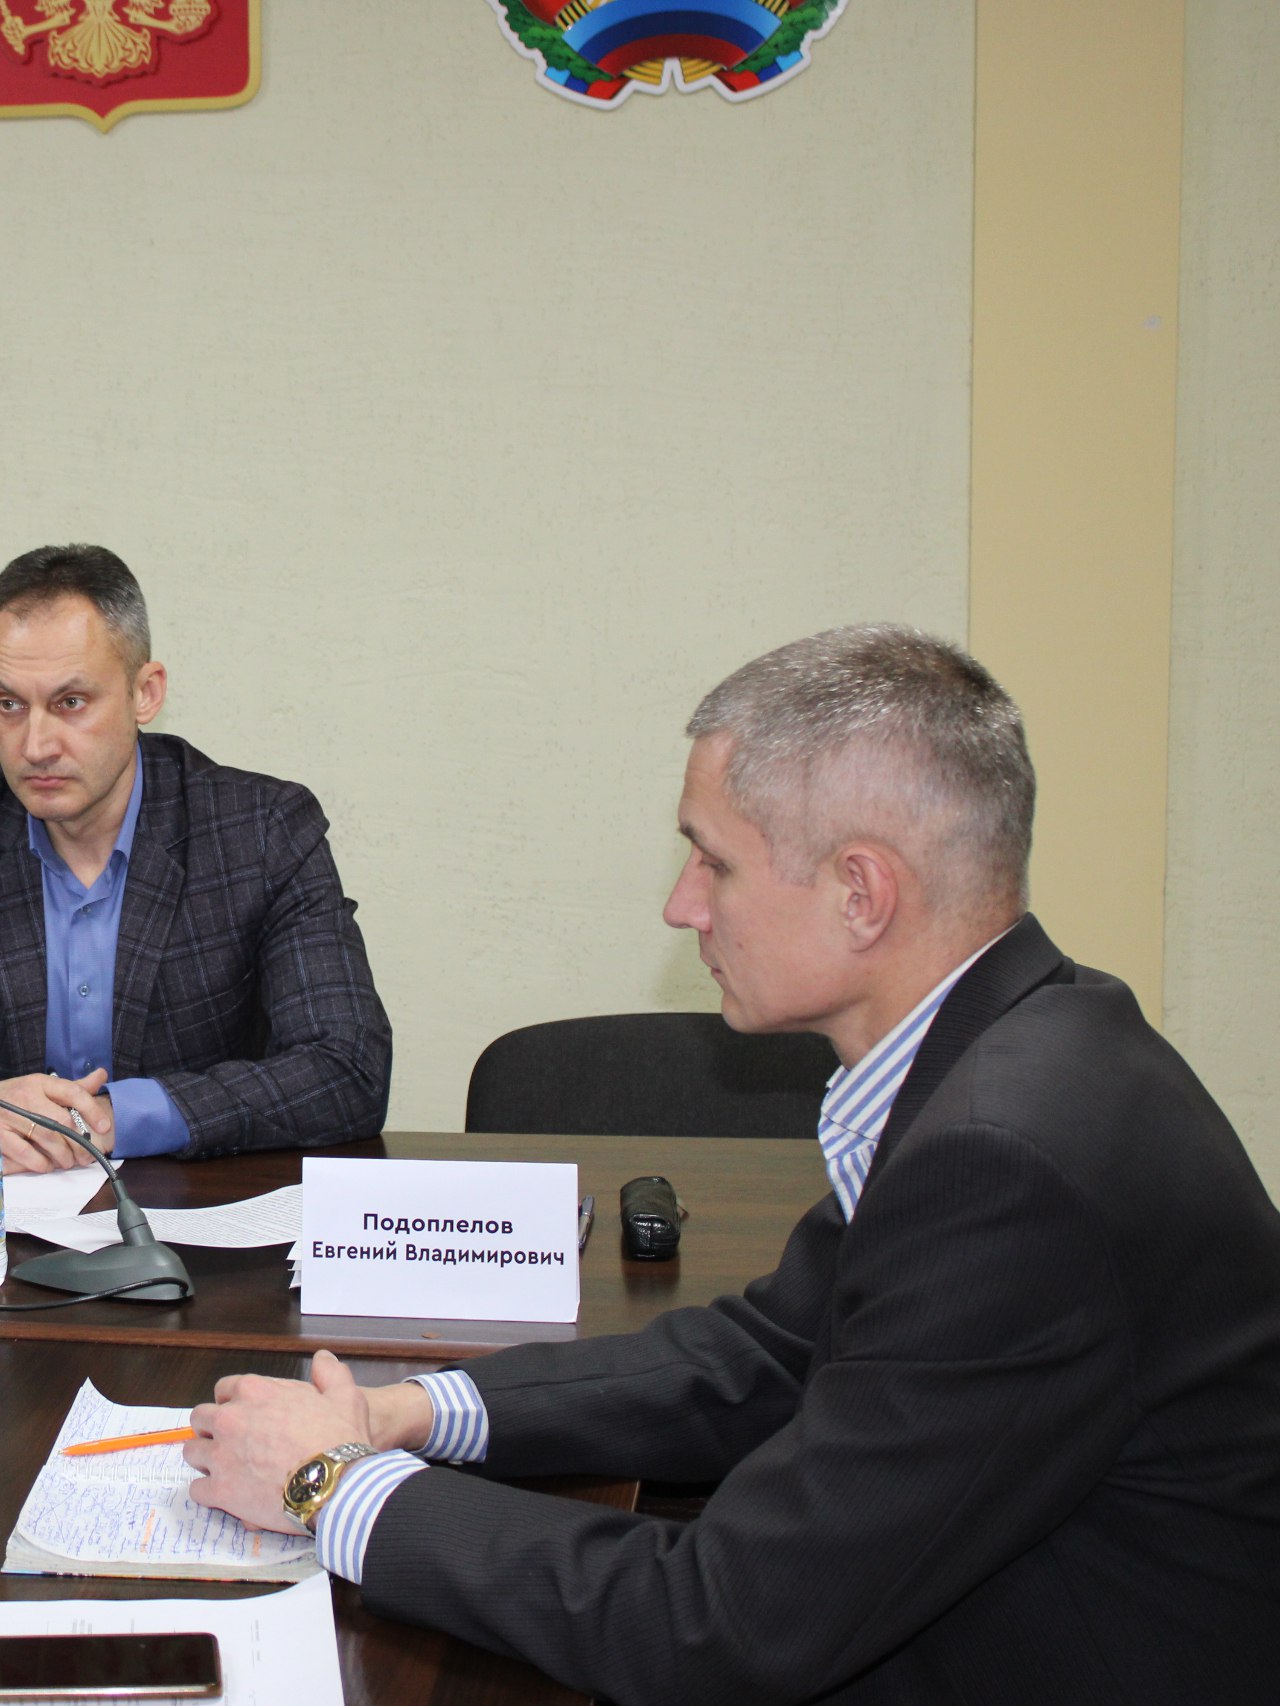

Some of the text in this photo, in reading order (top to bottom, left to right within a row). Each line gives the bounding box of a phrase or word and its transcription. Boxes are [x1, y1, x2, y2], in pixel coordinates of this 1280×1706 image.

[363, 1213, 514, 1235] Подоплелов
[312, 1240, 565, 1268] Евгений Владимирович
